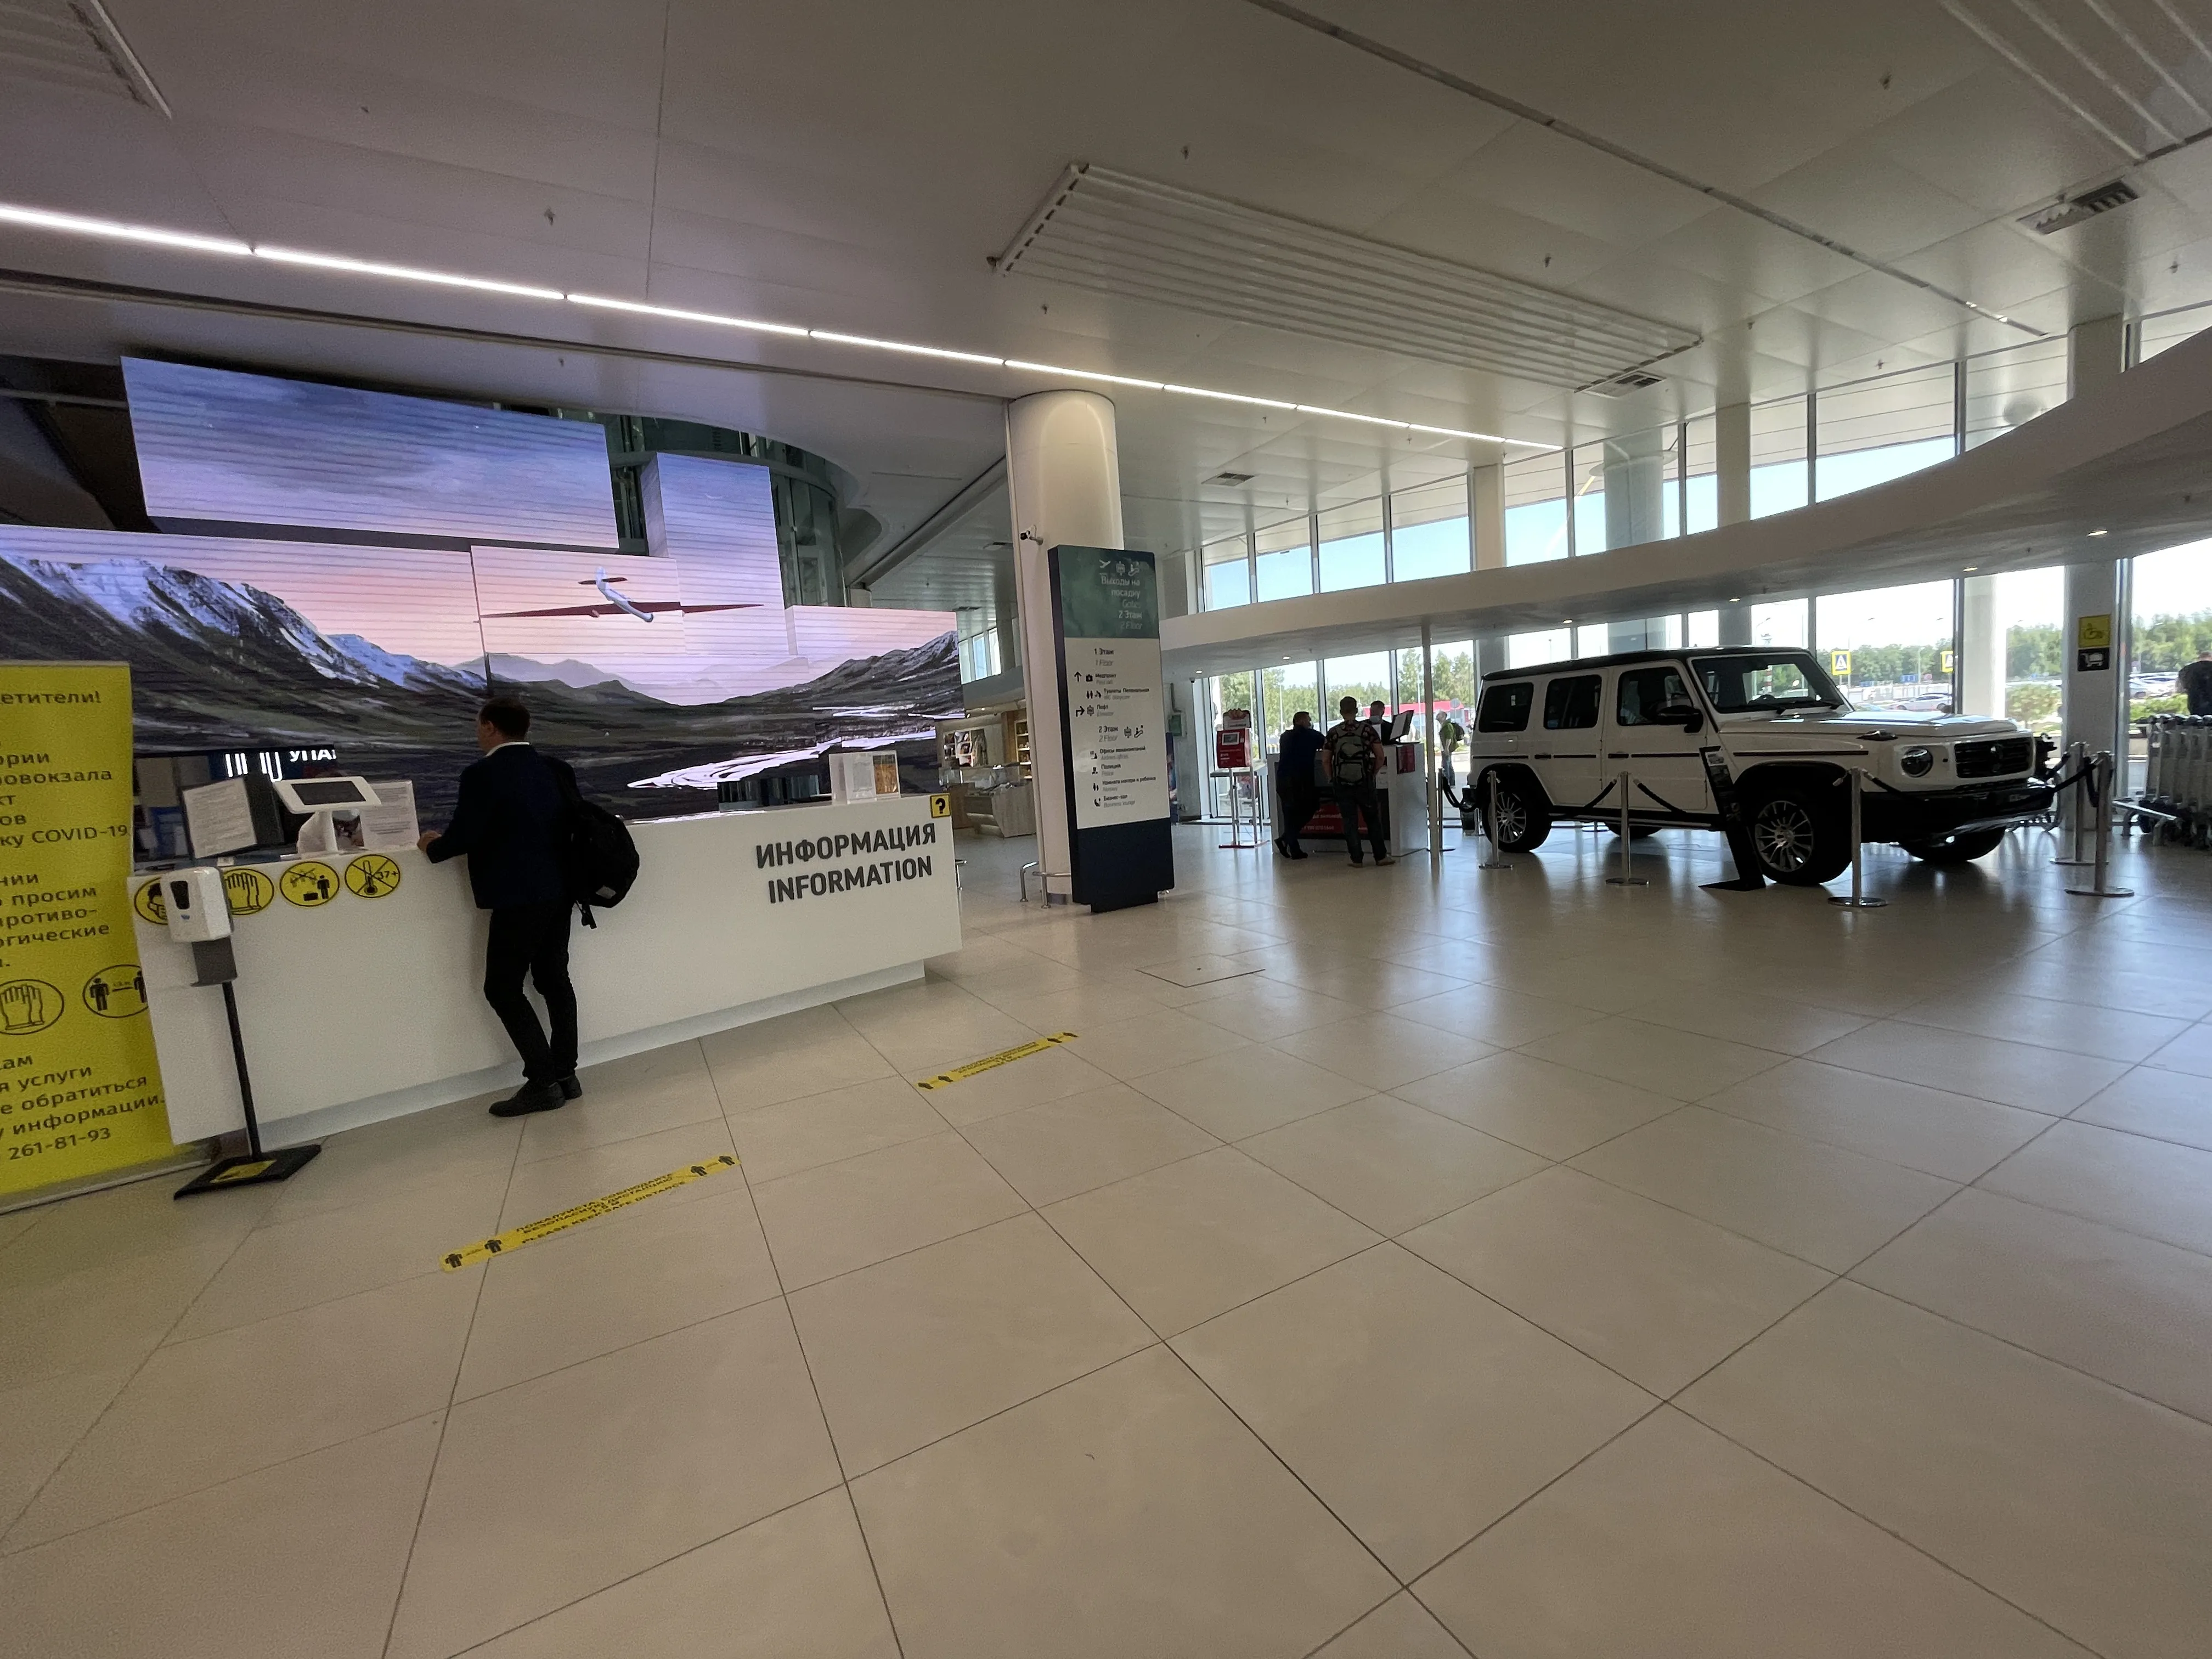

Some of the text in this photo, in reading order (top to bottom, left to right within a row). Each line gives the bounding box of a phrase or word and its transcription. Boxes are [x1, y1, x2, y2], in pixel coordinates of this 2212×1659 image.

[1111, 589, 1141, 599] посадку
[1119, 610, 1123, 619] 2
[0, 771, 112, 786] овокзала
[756, 823, 936, 869] ИНФОРМАЦИЯ
[769, 855, 932, 904] INFORMATION
[12, 887, 97, 907] просим
[0, 908, 98, 929] ротиво-
[0, 1054, 33, 1070] ам
[18, 1067, 92, 1092] услуги
[21, 1076, 148, 1108] обратиться
[13, 1094, 165, 1135] информации.
[8, 1127, 111, 1160] 261-81-93
